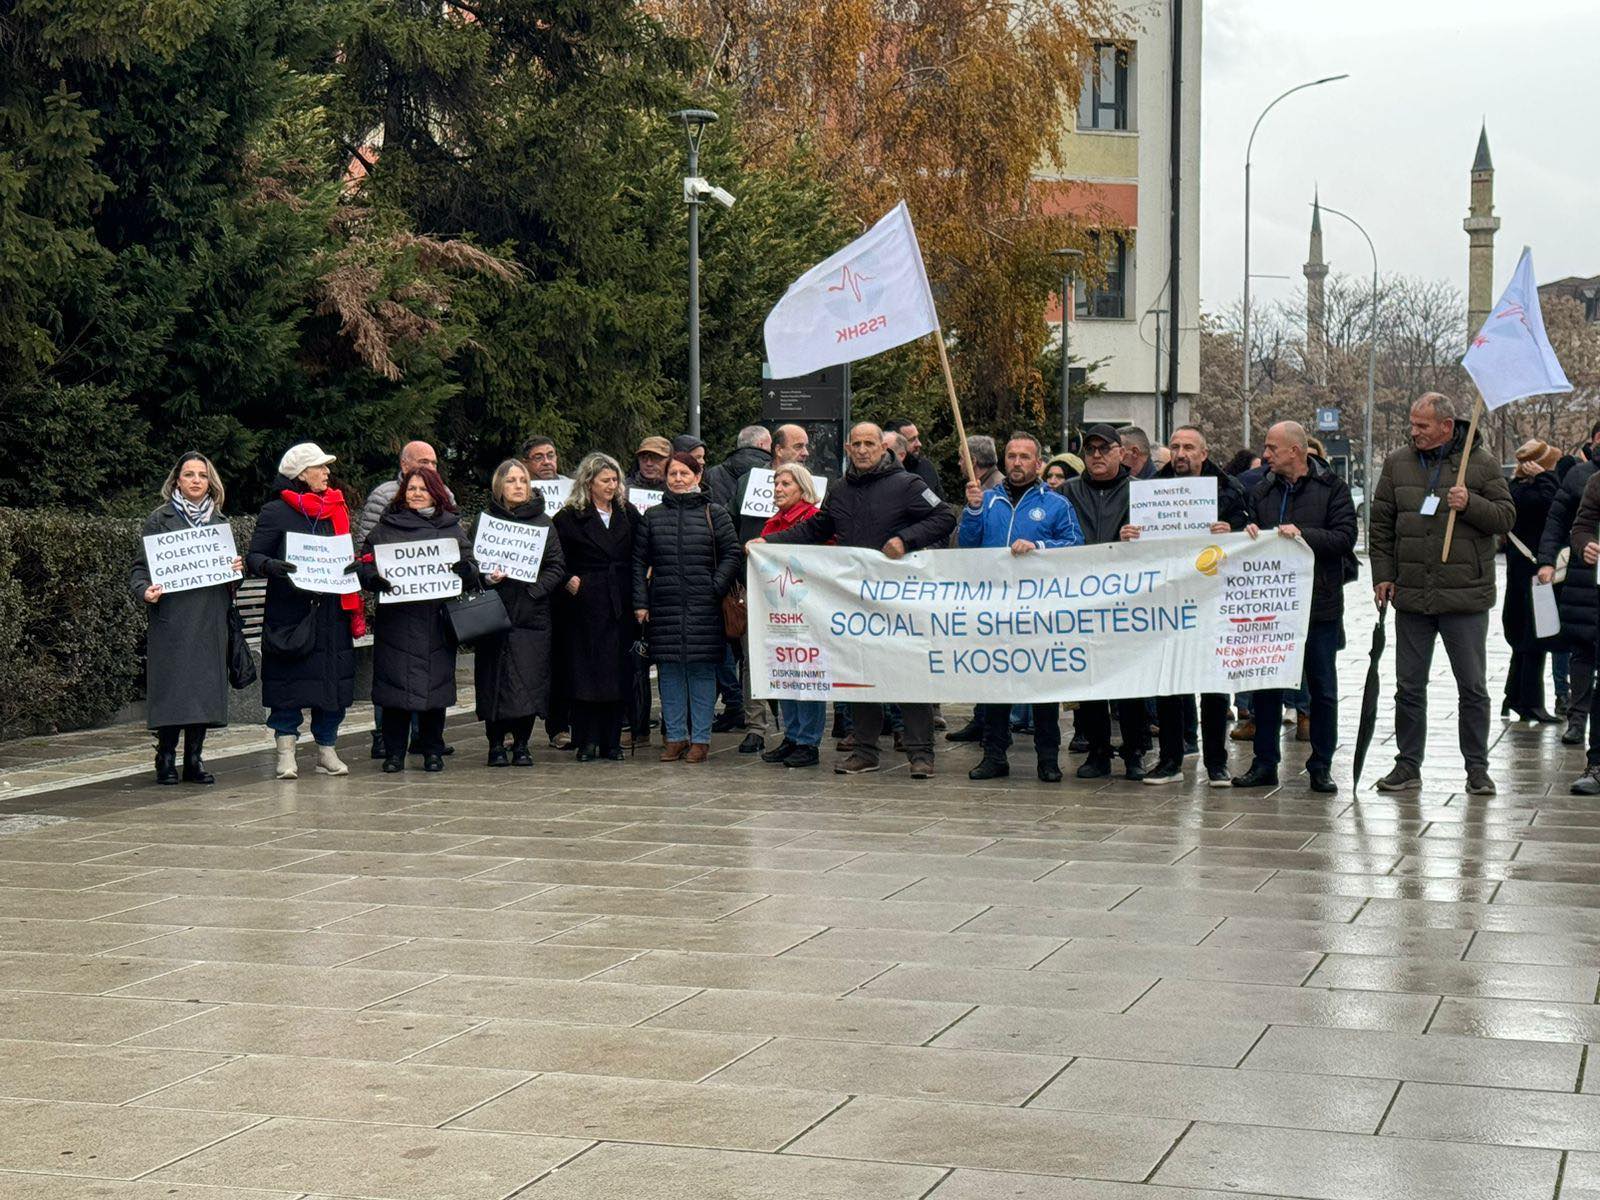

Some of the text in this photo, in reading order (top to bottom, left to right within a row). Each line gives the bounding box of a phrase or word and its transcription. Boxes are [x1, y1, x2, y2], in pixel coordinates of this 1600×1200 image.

[1131, 498, 1216, 509] KONTRATA KOLEKTIVE
[1157, 511, 1181, 519] ËSHTË
[488, 519, 541, 538] KONTRATA
[1161, 522, 1182, 531] JONË
[157, 527, 220, 546] KONTRATA
[481, 531, 537, 552] KOLEKTIVE
[155, 542, 221, 561] KOLEKTIVE
[394, 544, 440, 560] DUAM
[476, 544, 539, 566] GARANCI PËR
[155, 555, 234, 577] GARANCI PËR
[384, 561, 453, 579] KONTRAT
[1242, 559, 1281, 573] DUAM
[860, 570, 1161, 601] NDËRTIMI I DIALOGUT
[1226, 571, 1297, 587] KONTRATË
[1225, 587, 1297, 601] KOLEKTIVE
[1219, 600, 1300, 615] SEKTORIALE
[769, 612, 804, 624] FSSHK
[830, 599, 1198, 637] SOCIAL NË SHËNDETËSINË
[1236, 621, 1281, 633] DURIMIT
[1226, 634, 1260, 645] ERDHI
[1262, 632, 1295, 643] FUNDI
[775, 646, 820, 663] STOP
[1215, 642, 1296, 656] NËNSHKRUAJE
[928, 641, 1087, 674] E KOSOVËS
[1222, 654, 1286, 669] KONTRATËN
